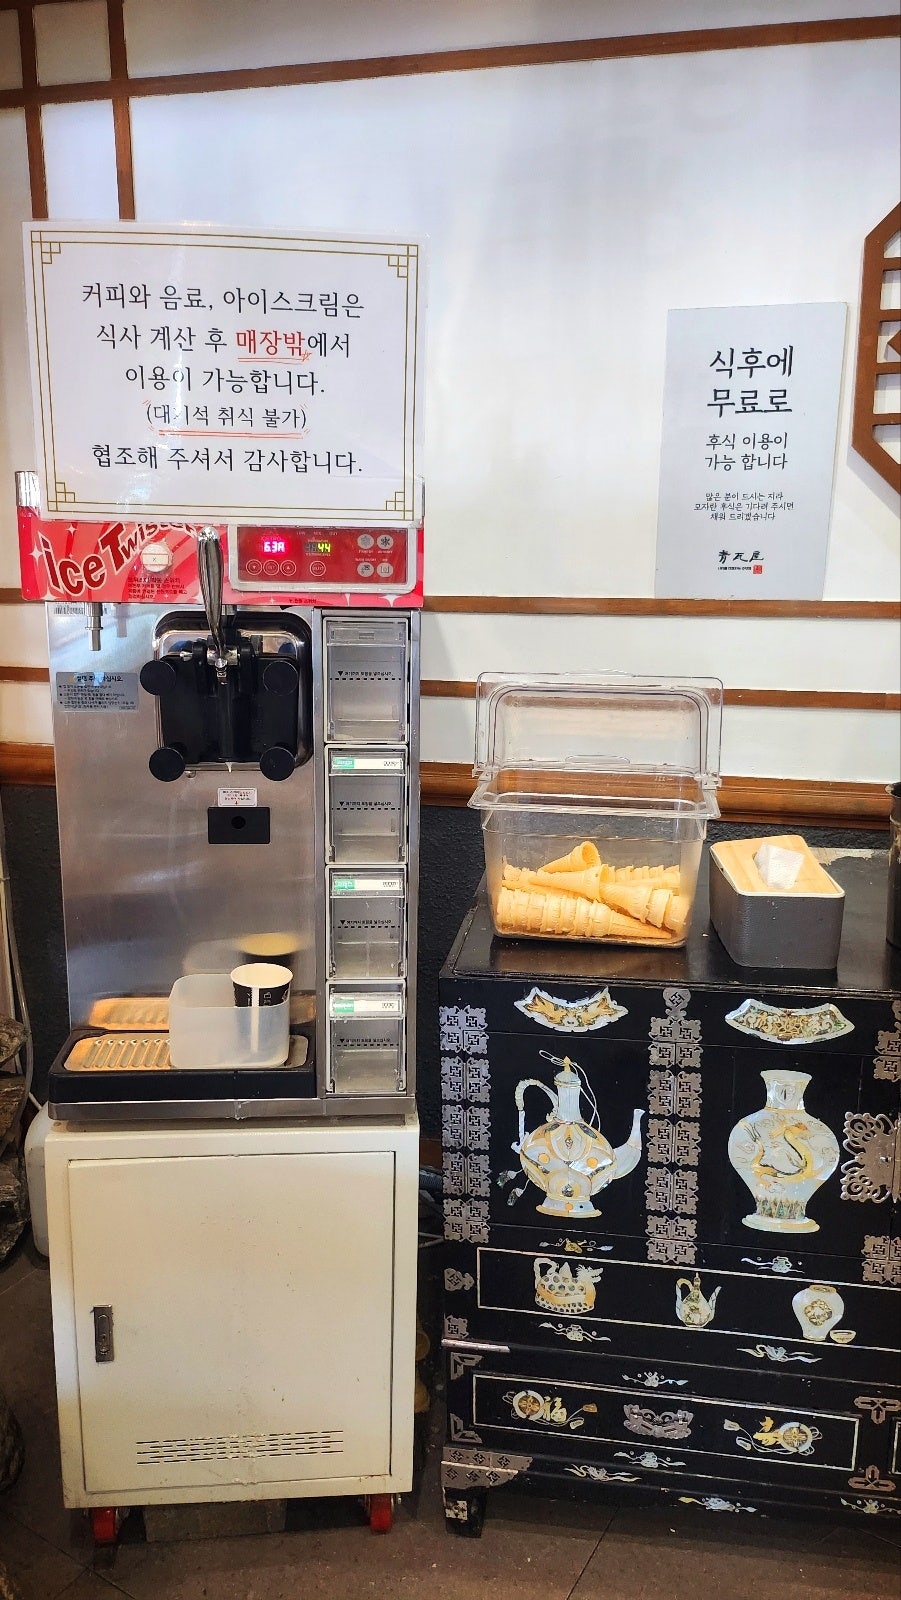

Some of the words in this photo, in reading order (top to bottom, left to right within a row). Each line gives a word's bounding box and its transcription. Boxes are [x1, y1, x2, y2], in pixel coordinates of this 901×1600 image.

[82, 283, 151, 309] 커피와
[160, 285, 213, 311] 음료,
[223, 287, 364, 318] 아이스크림은
[97, 324, 141, 350] 식사
[150, 326, 197, 352] 계산
[205, 327, 227, 353] 후
[236, 330, 350, 358] 매장밖에서
[709, 345, 793, 379] 식후에
[125, 366, 191, 391] 이용이
[202, 368, 325, 396] 가능합니다.
[707, 389, 792, 418] 무료로
[218, 406, 253, 428] 취식
[262, 408, 307, 429] 불가)
[706, 434, 735, 450] 후식
[742, 432, 787, 450] 이용이
[92, 445, 158, 469] 협조해
[167, 447, 233, 472] 주셔서
[244, 449, 362, 474] 감사합니다.
[705, 454, 736, 471] 가능
[741, 453, 787, 471] 합니다
[694, 502, 717, 511] 모자란
[721, 502, 742, 511] 후식은
[745, 502, 768, 510] 기다려
[771, 502, 794, 510] 주시면
[724, 492, 738, 501] 분이
[742, 492, 765, 501] 드시는
[729, 512, 775, 521] 드리겠습니다
